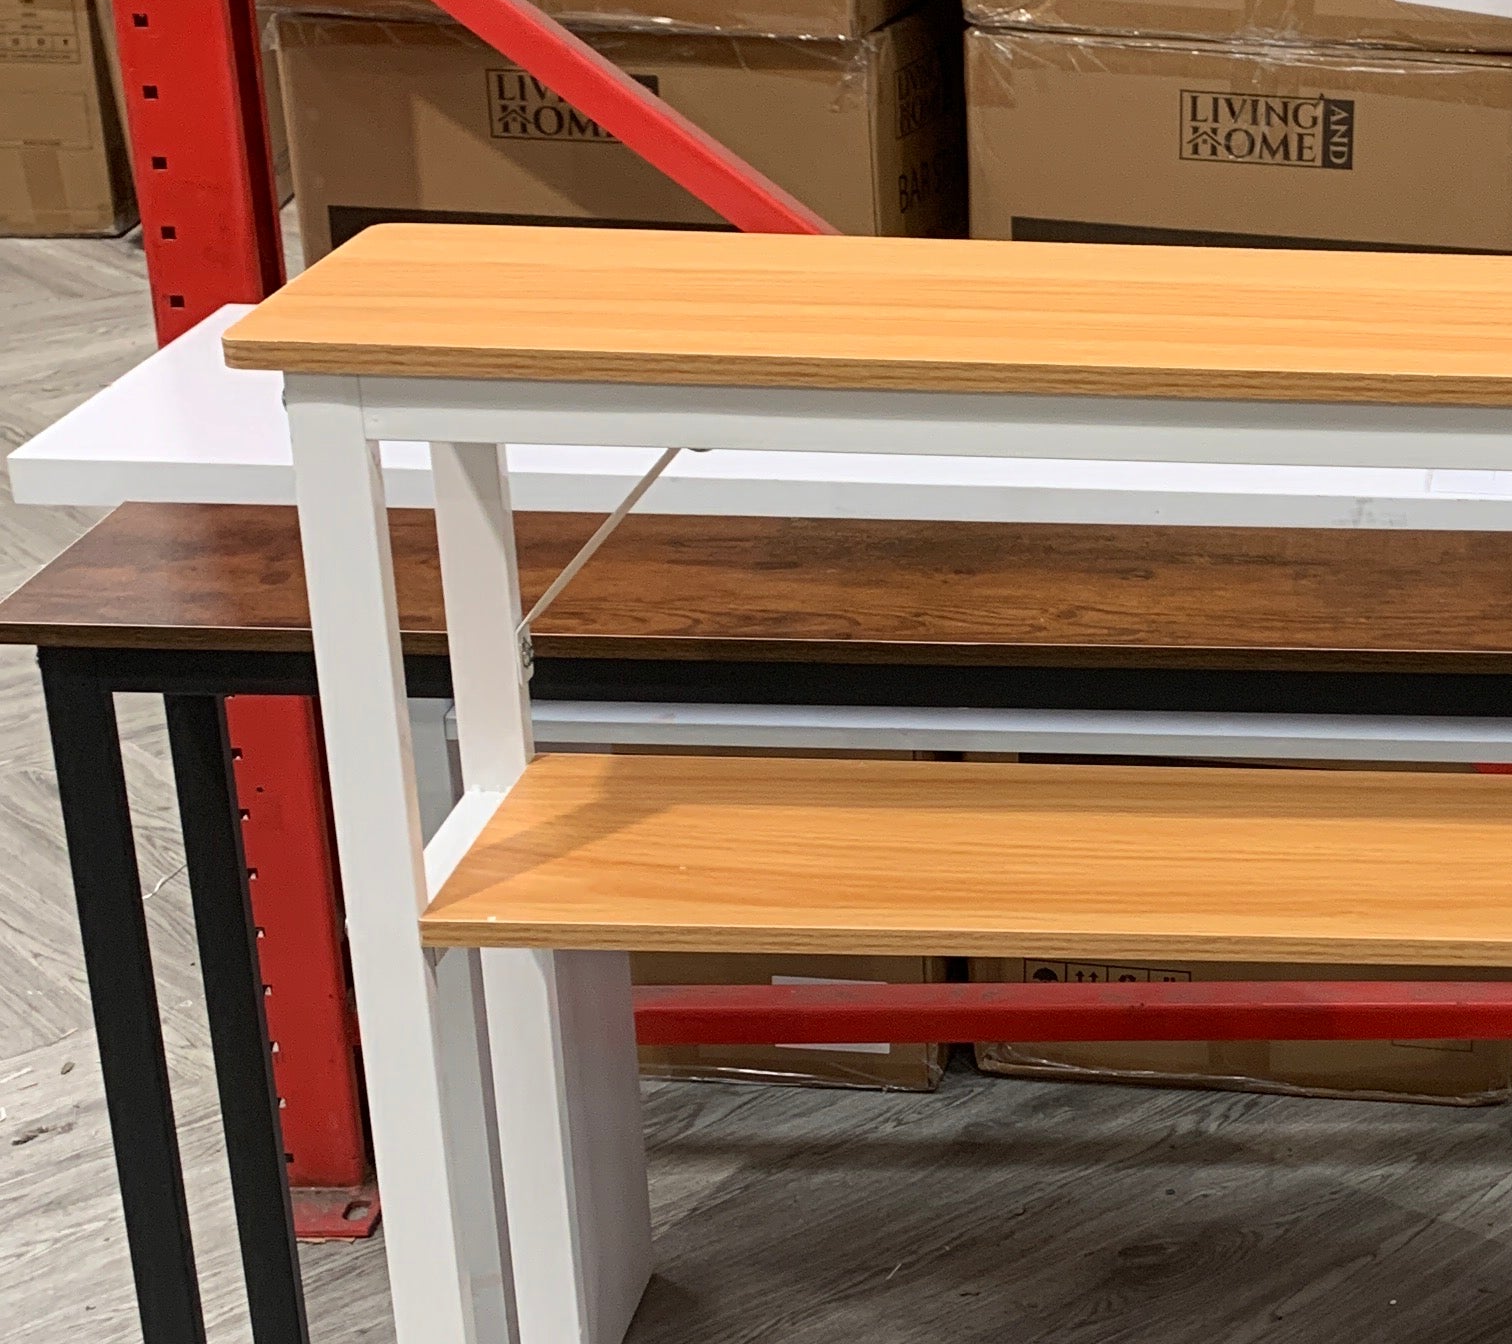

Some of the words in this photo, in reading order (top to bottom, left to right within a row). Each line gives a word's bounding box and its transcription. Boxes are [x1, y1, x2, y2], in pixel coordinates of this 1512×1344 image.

[498, 104, 602, 137] HOM
[1190, 95, 1319, 130] LIVING
[1187, 126, 1317, 163] HOME
[1329, 106, 1349, 165] AND
